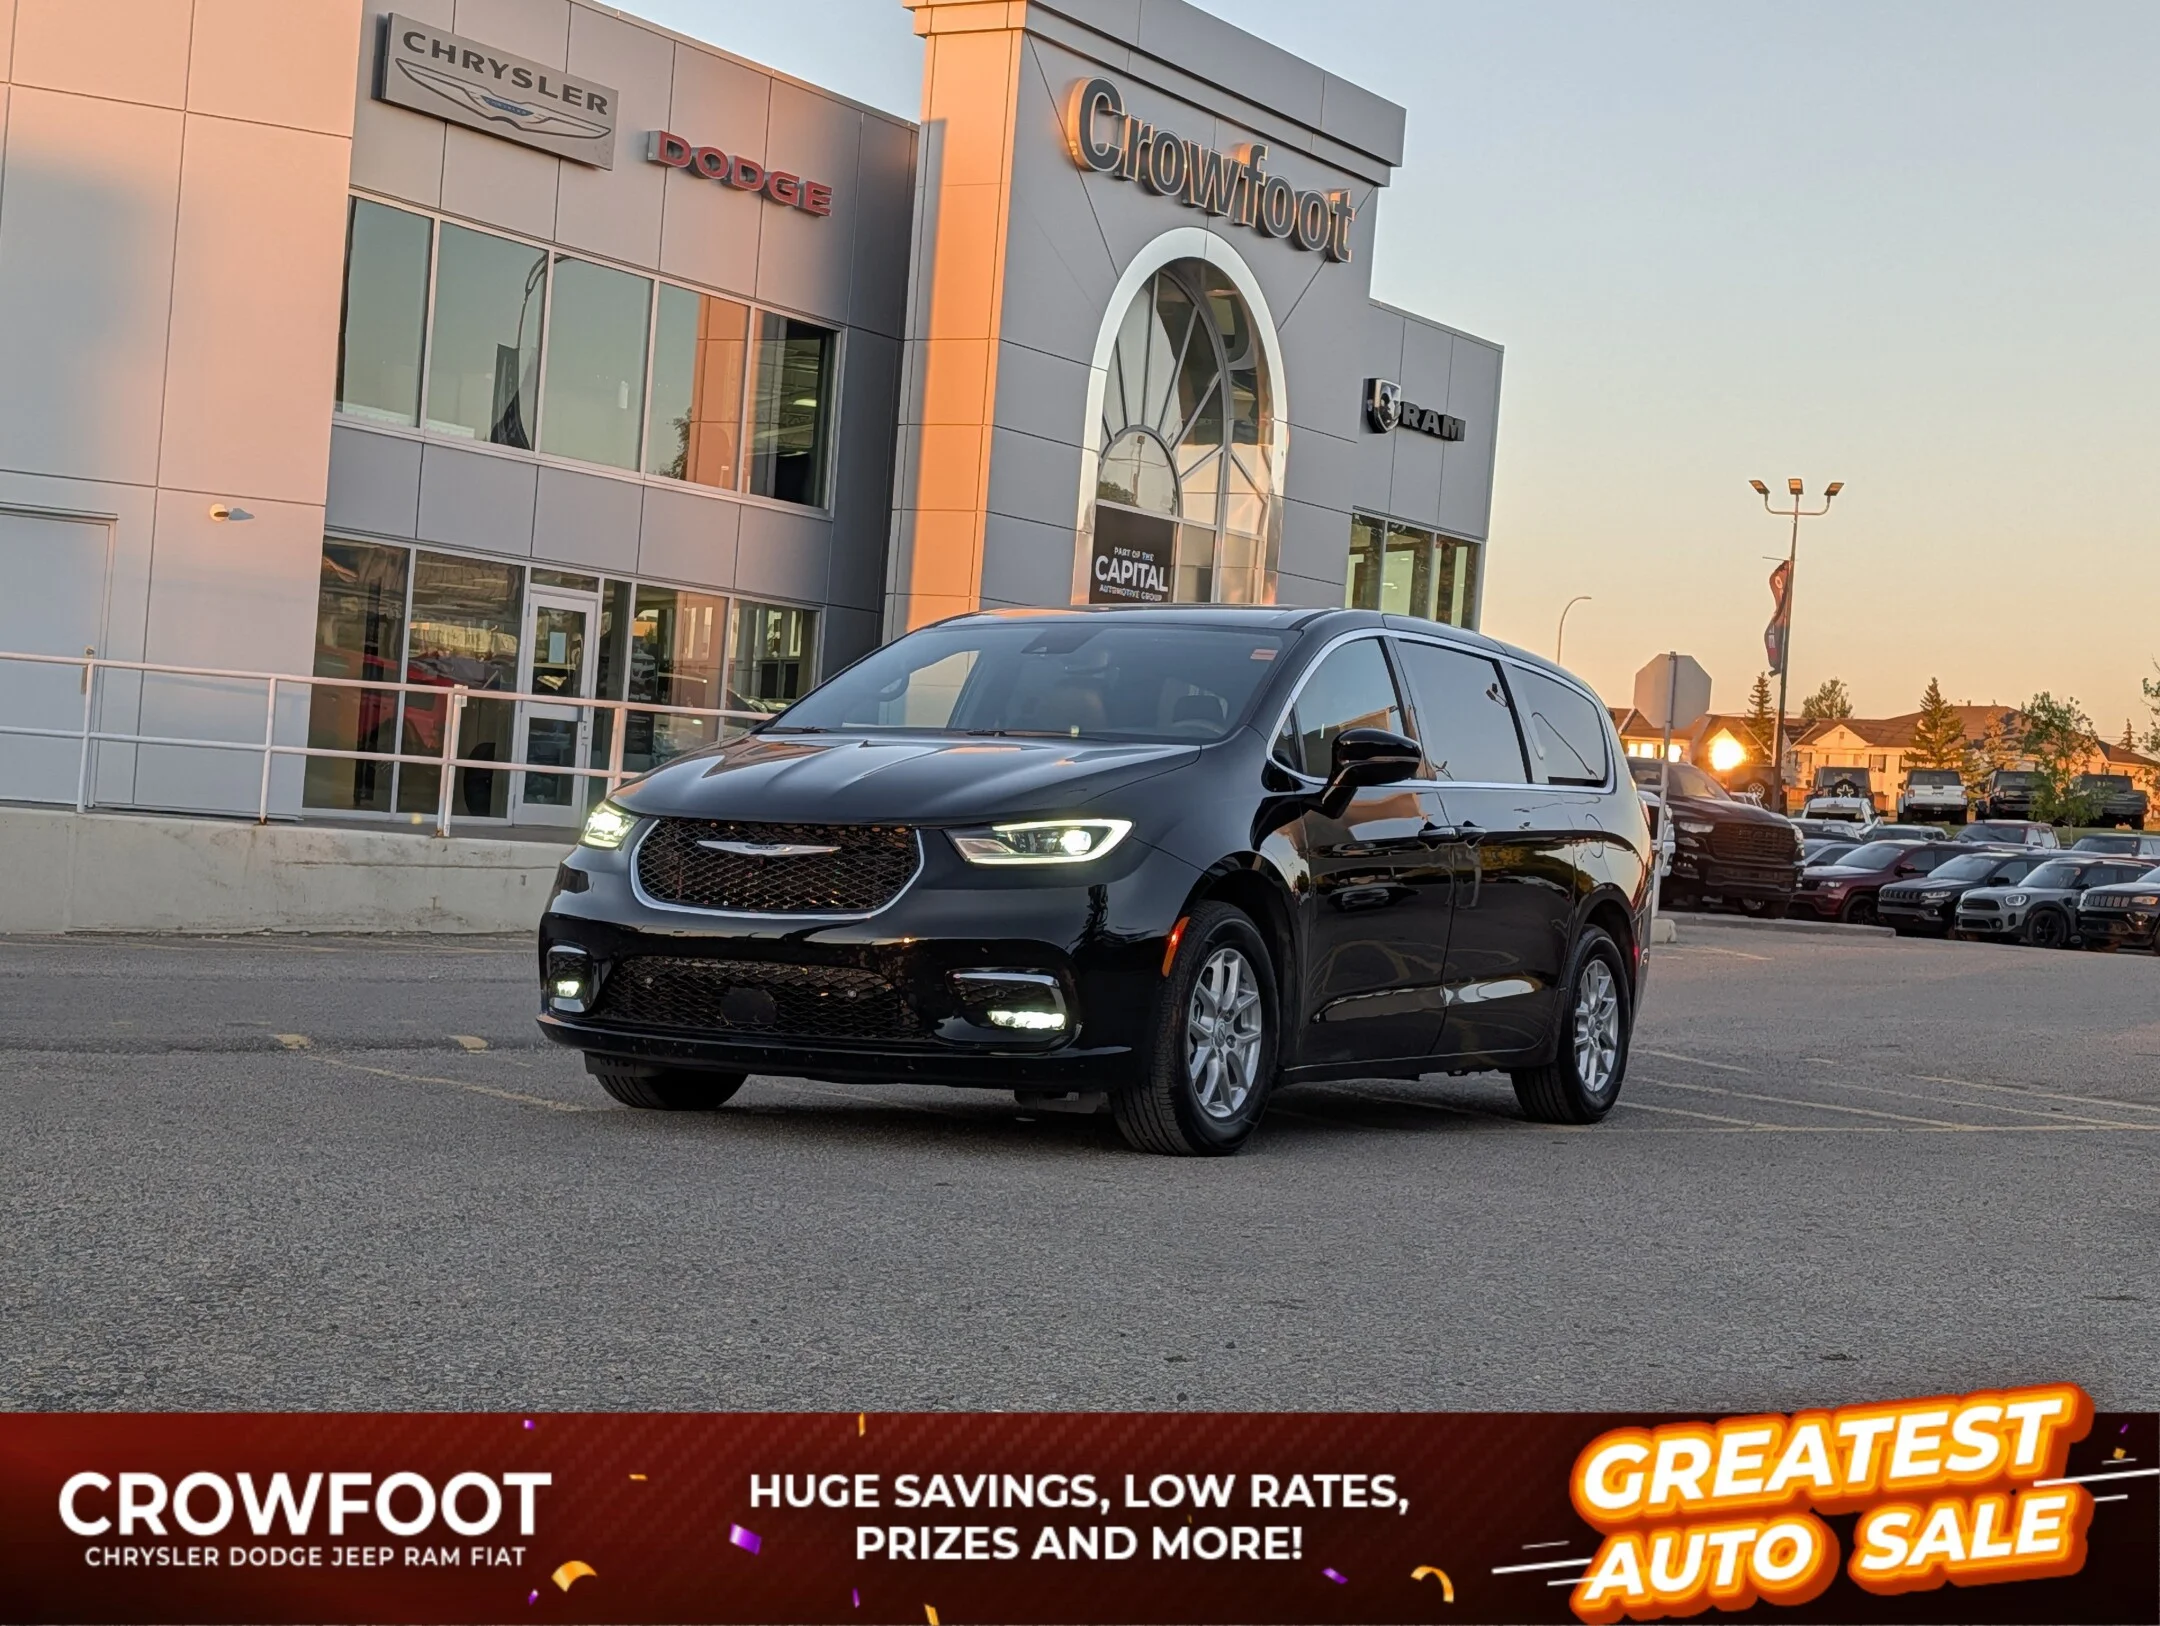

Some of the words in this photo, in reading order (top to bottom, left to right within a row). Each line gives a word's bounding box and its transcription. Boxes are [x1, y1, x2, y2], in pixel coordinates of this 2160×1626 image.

[403, 31, 608, 116] CHRYSLER
[649, 130, 833, 216] DODGE
[1069, 76, 1356, 263] Crowfoot
[1400, 401, 1466, 442] RAM
[1095, 555, 1169, 592] CAPITAL
[1113, 546, 1131, 557] PART
[1132, 550, 1141, 558] OF
[1142, 552, 1155, 561] THE
[1099, 584, 1140, 599] AUTOMOTIVE
[1141, 591, 1162, 601] GROUP
